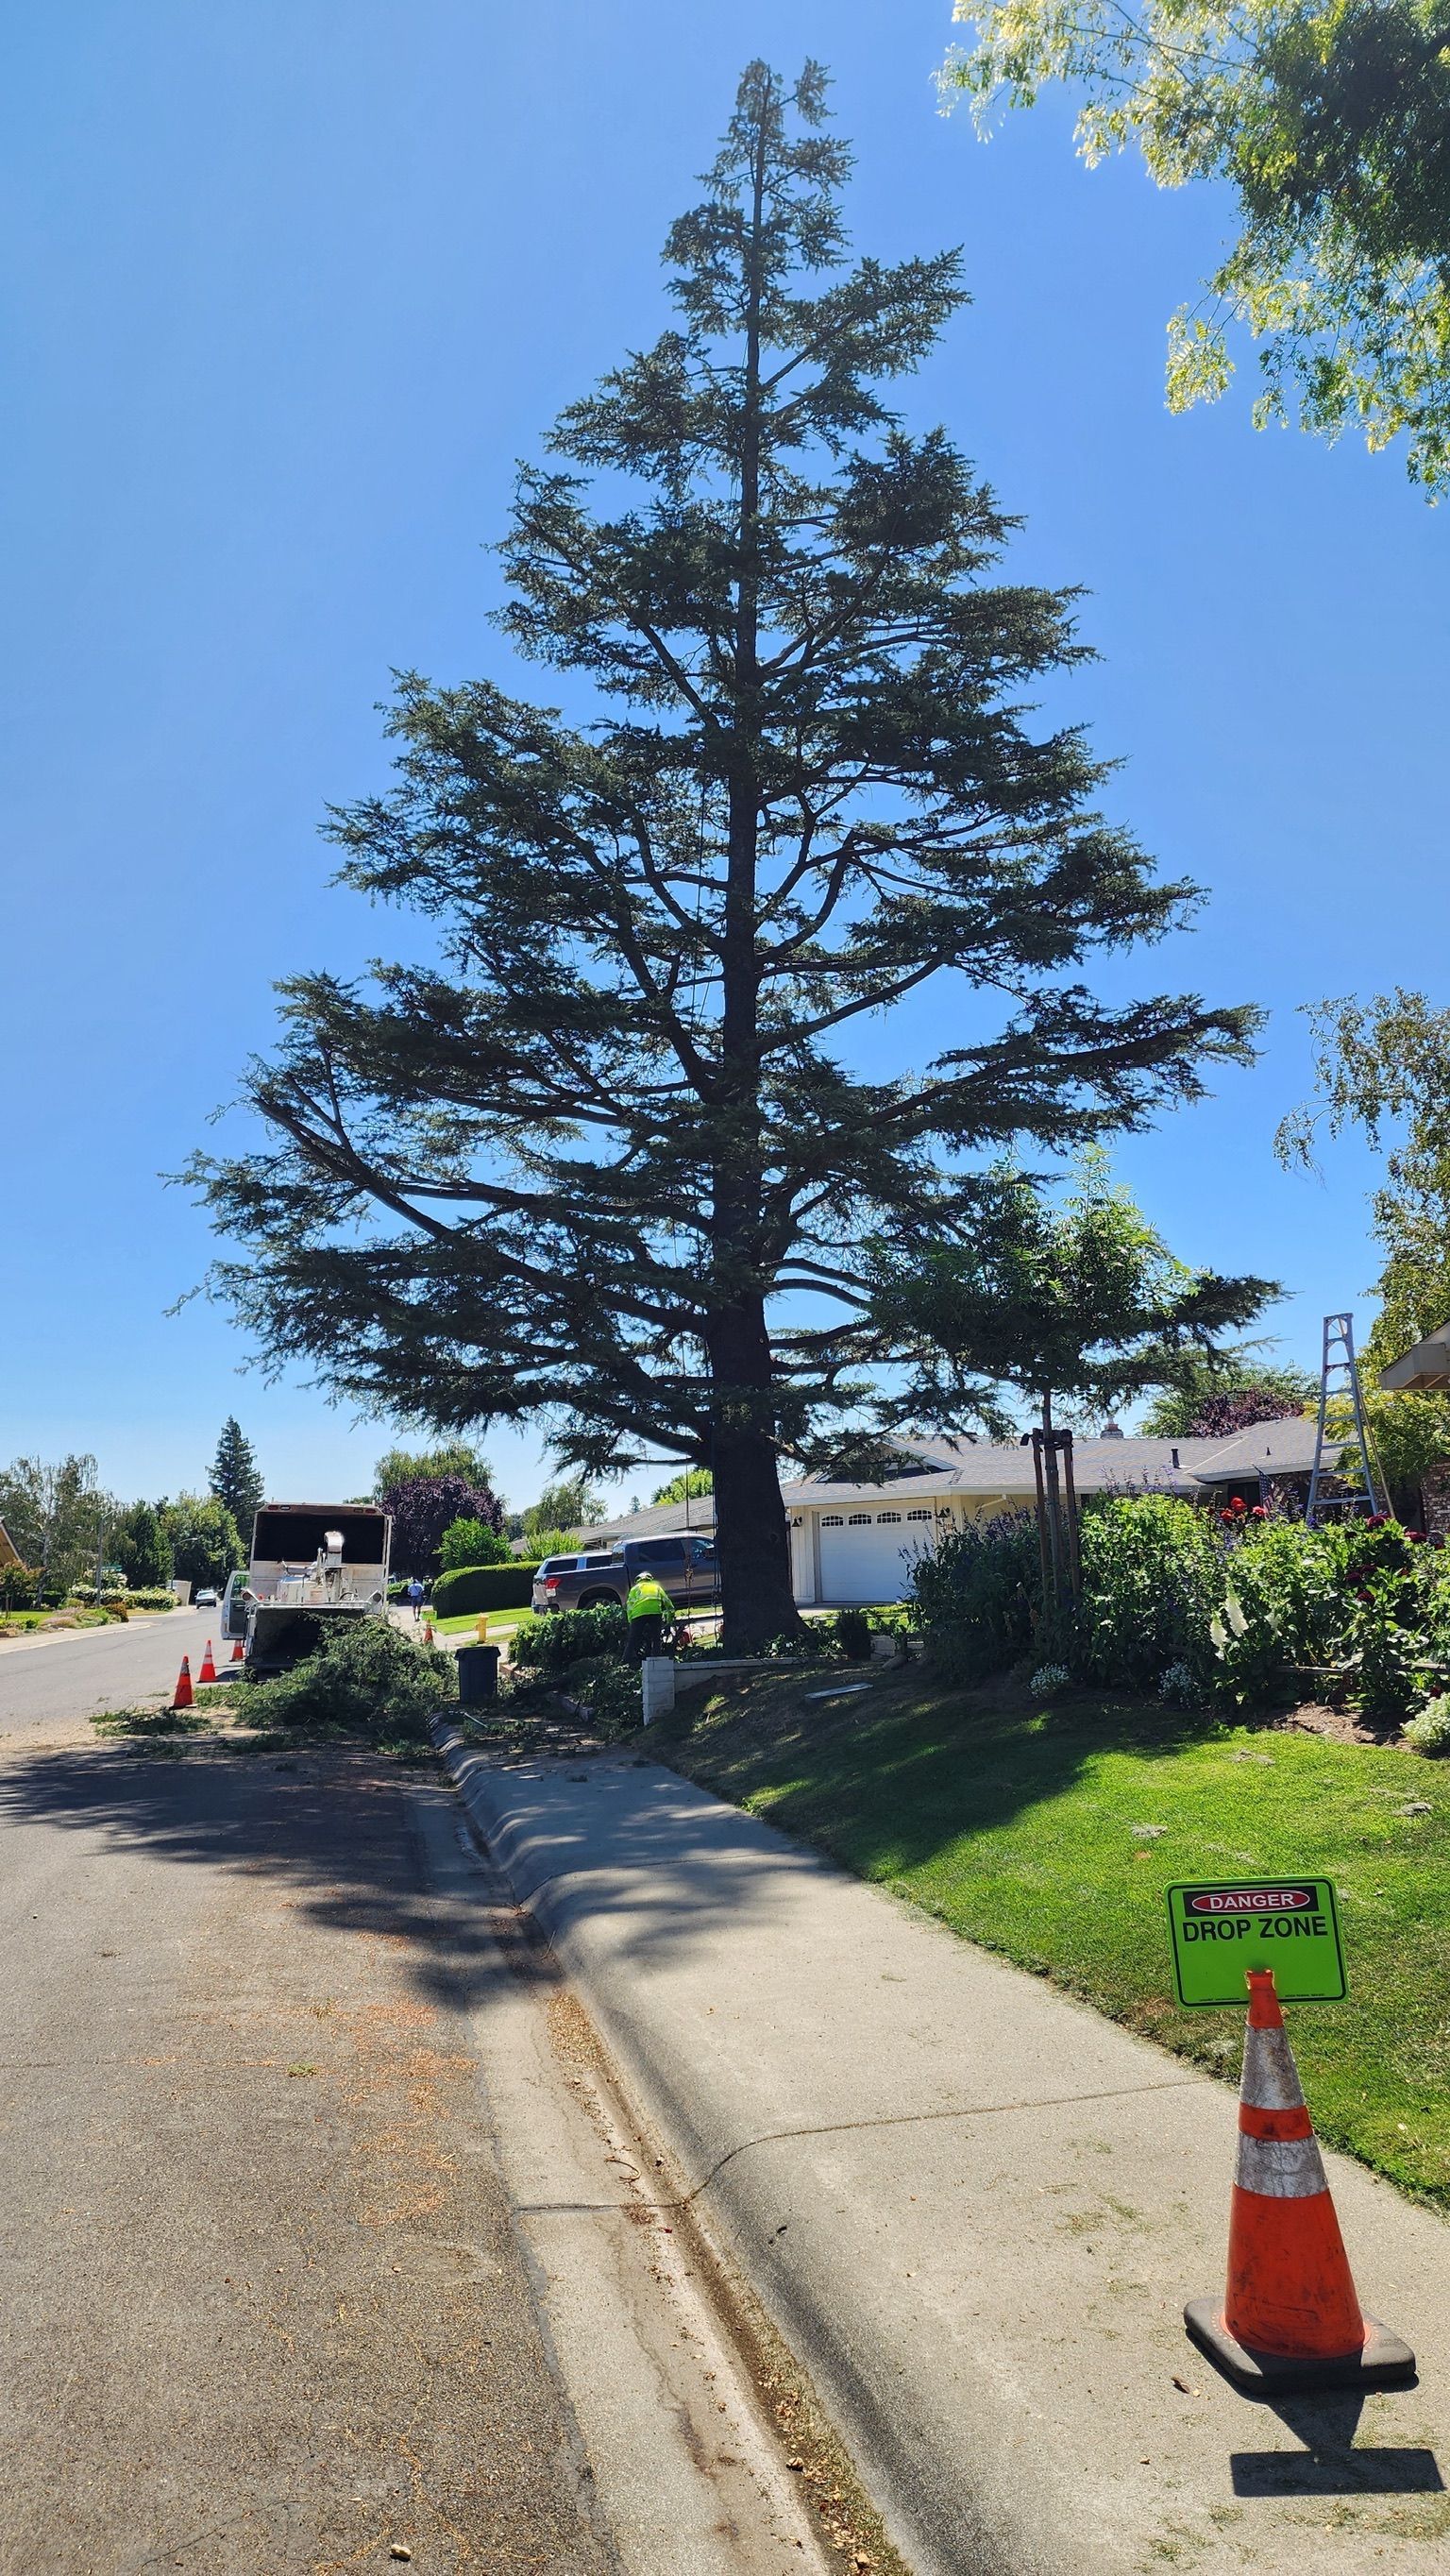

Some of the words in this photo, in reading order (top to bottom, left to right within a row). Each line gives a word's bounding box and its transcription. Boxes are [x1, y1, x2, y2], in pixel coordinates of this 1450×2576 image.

[1209, 1893, 1295, 1909] DANGER
[1183, 1919, 1252, 1942] DROP
[1258, 1916, 1328, 1939] ZONE
